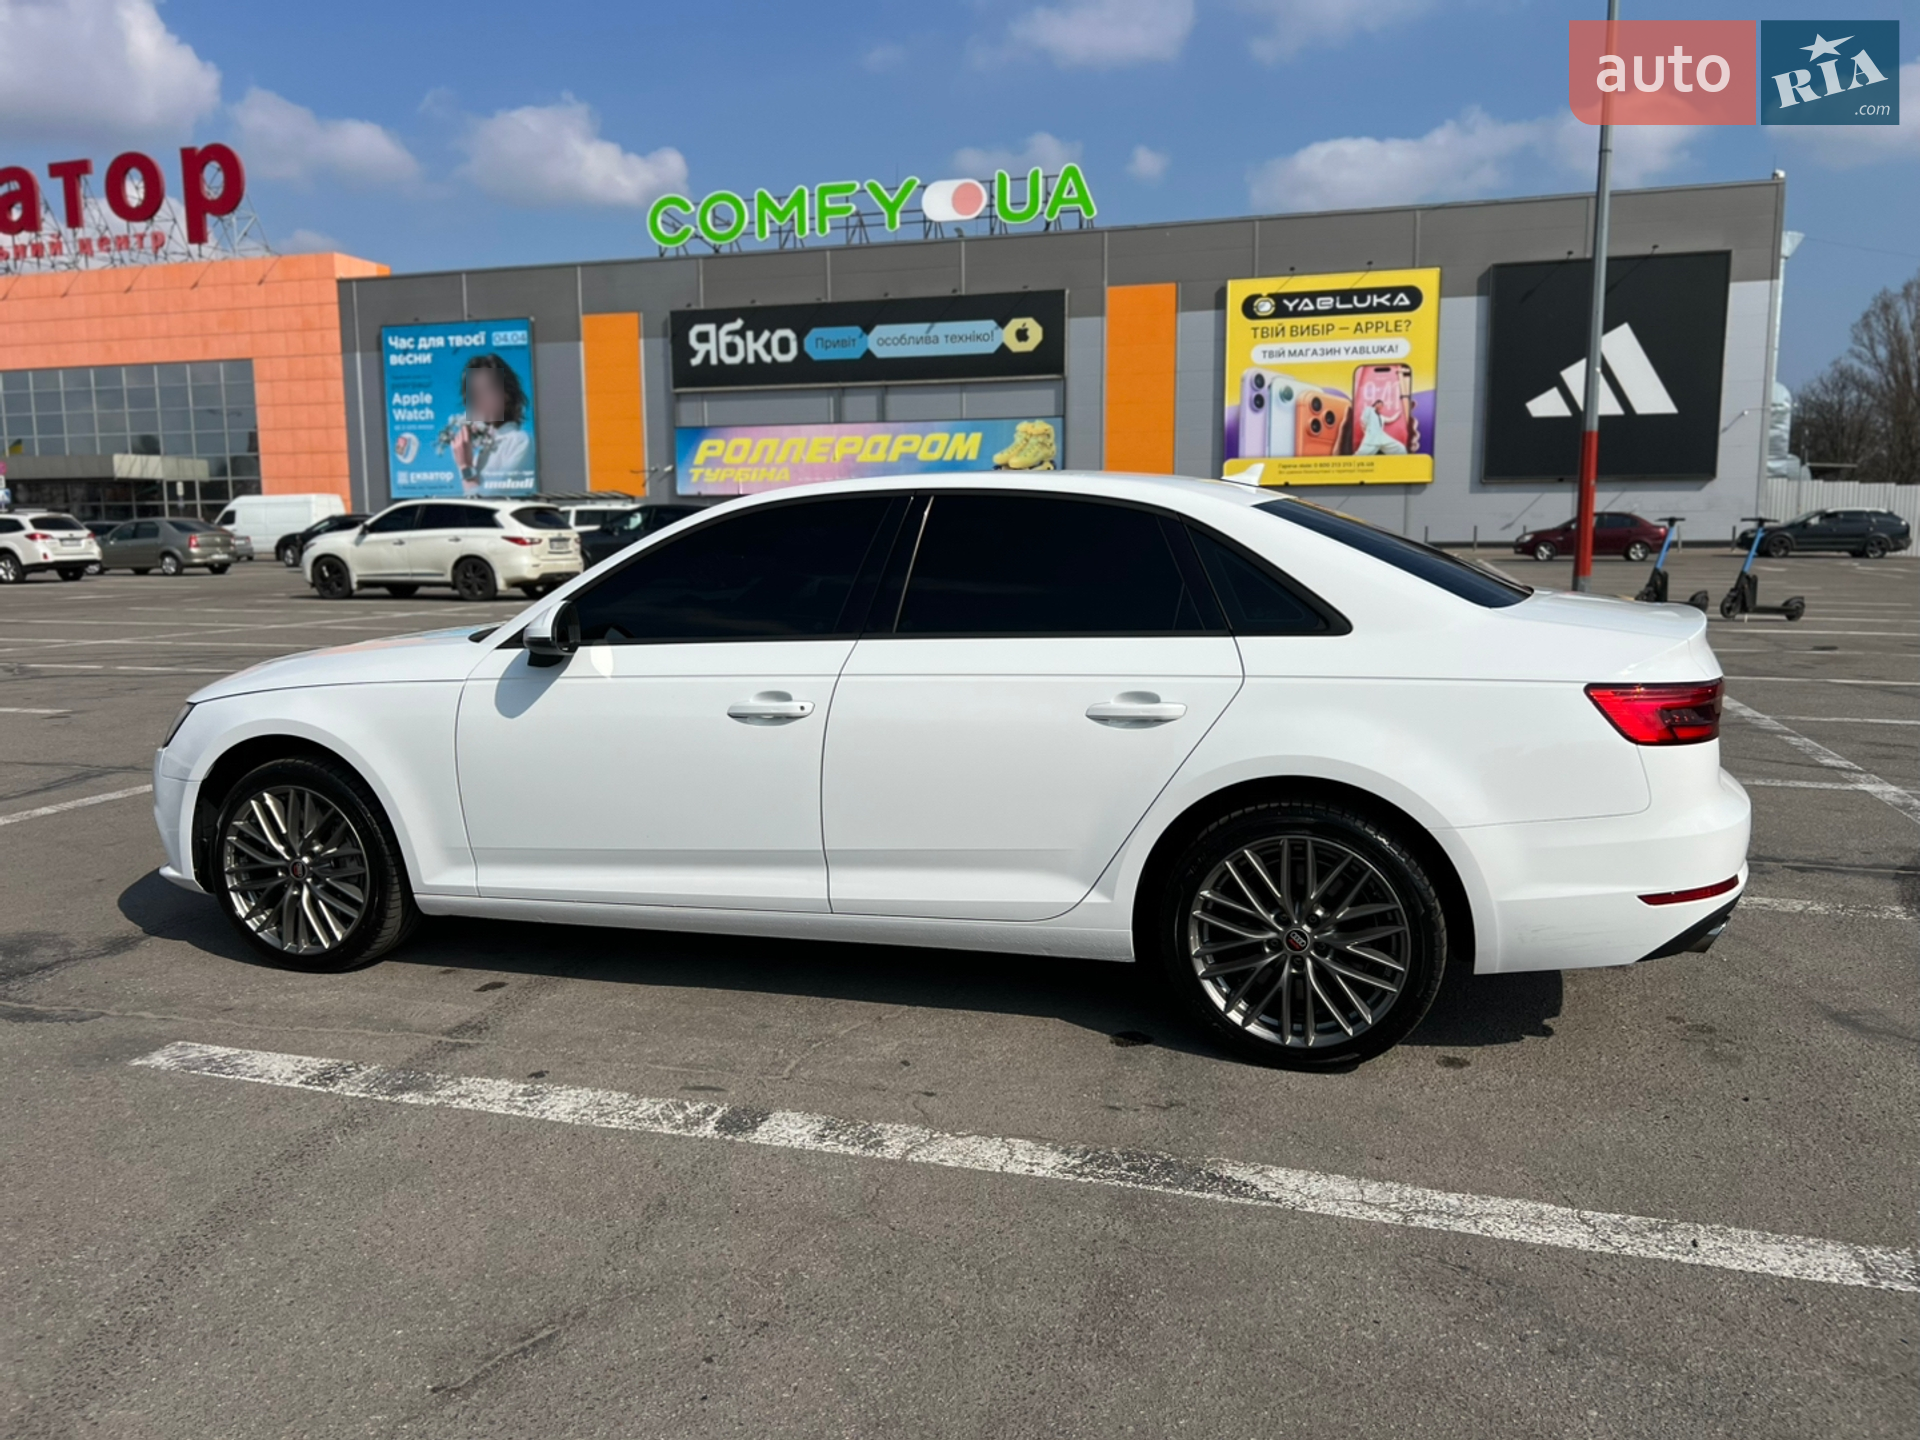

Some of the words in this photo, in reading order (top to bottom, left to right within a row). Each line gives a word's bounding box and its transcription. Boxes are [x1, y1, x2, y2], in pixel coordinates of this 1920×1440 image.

[0, 143, 246, 245] атор
[647, 175, 921, 249] COMFY
[994, 162, 1098, 225] UA
[77, 230, 166, 258] центр
[1283, 292, 1411, 312] YABLUKA
[1251, 323, 1286, 339] ТВІЙ
[1290, 322, 1335, 338] ВИБІР
[1353, 319, 1412, 335] APPLE?
[388, 335, 415, 350] Час
[418, 335, 445, 350] для
[688, 317, 798, 367] Ябко
[815, 336, 857, 351] Привіт
[876, 331, 940, 348] особлива
[944, 328, 995, 345] техніко!
[389, 353, 432, 366] весни
[1261, 346, 1286, 359] ТВІЙ
[1288, 346, 1341, 358] МАГАЗИН
[1343, 344, 1399, 356] YABLUKA!
[392, 391, 433, 407] Apple
[392, 407, 435, 422] Watch
[694, 431, 982, 466] РОЛЛЕРДРОМ
[689, 466, 791, 483] ТУРБІНА
